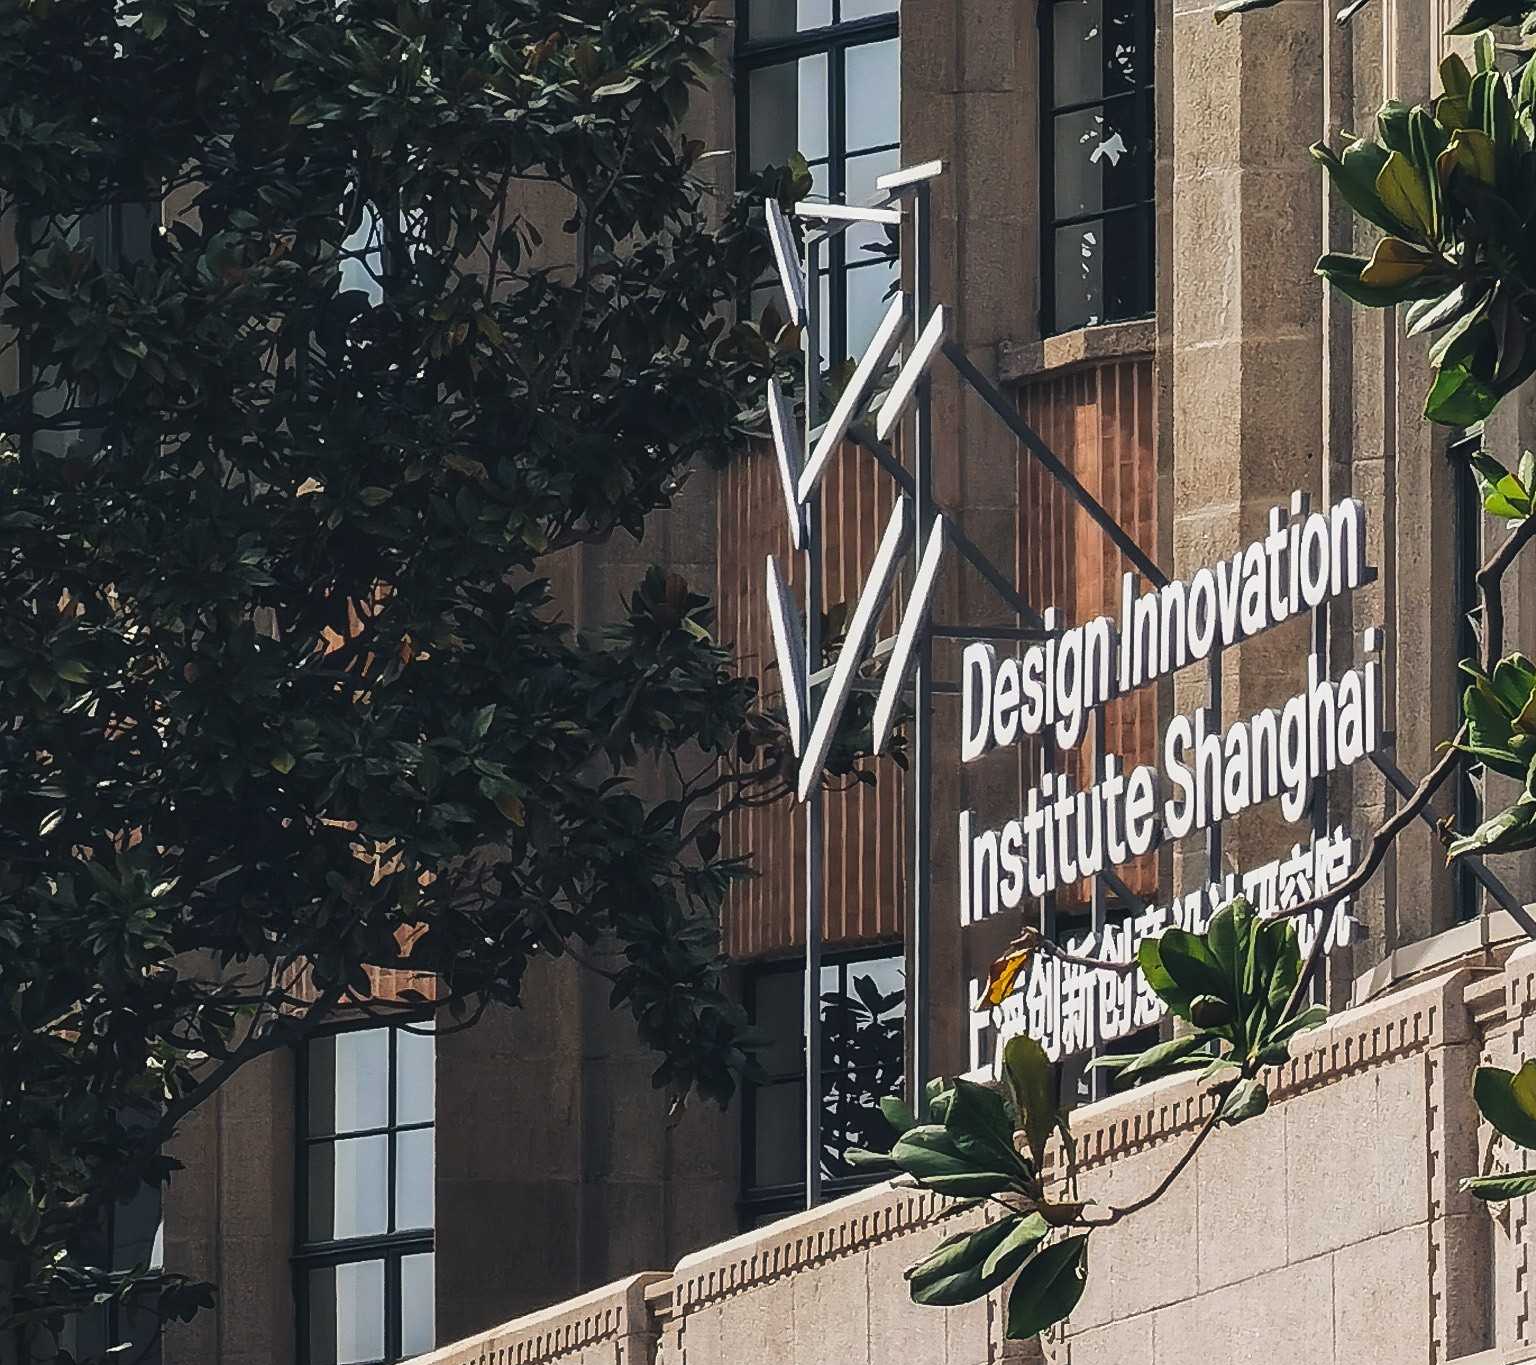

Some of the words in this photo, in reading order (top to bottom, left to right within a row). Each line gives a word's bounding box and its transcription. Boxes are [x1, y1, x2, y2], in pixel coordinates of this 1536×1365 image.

[962, 606, 1112, 763] Design
[1118, 489, 1362, 692] Innovation
[958, 753, 1155, 928] Institute
[1164, 627, 1376, 839] Shanghai
